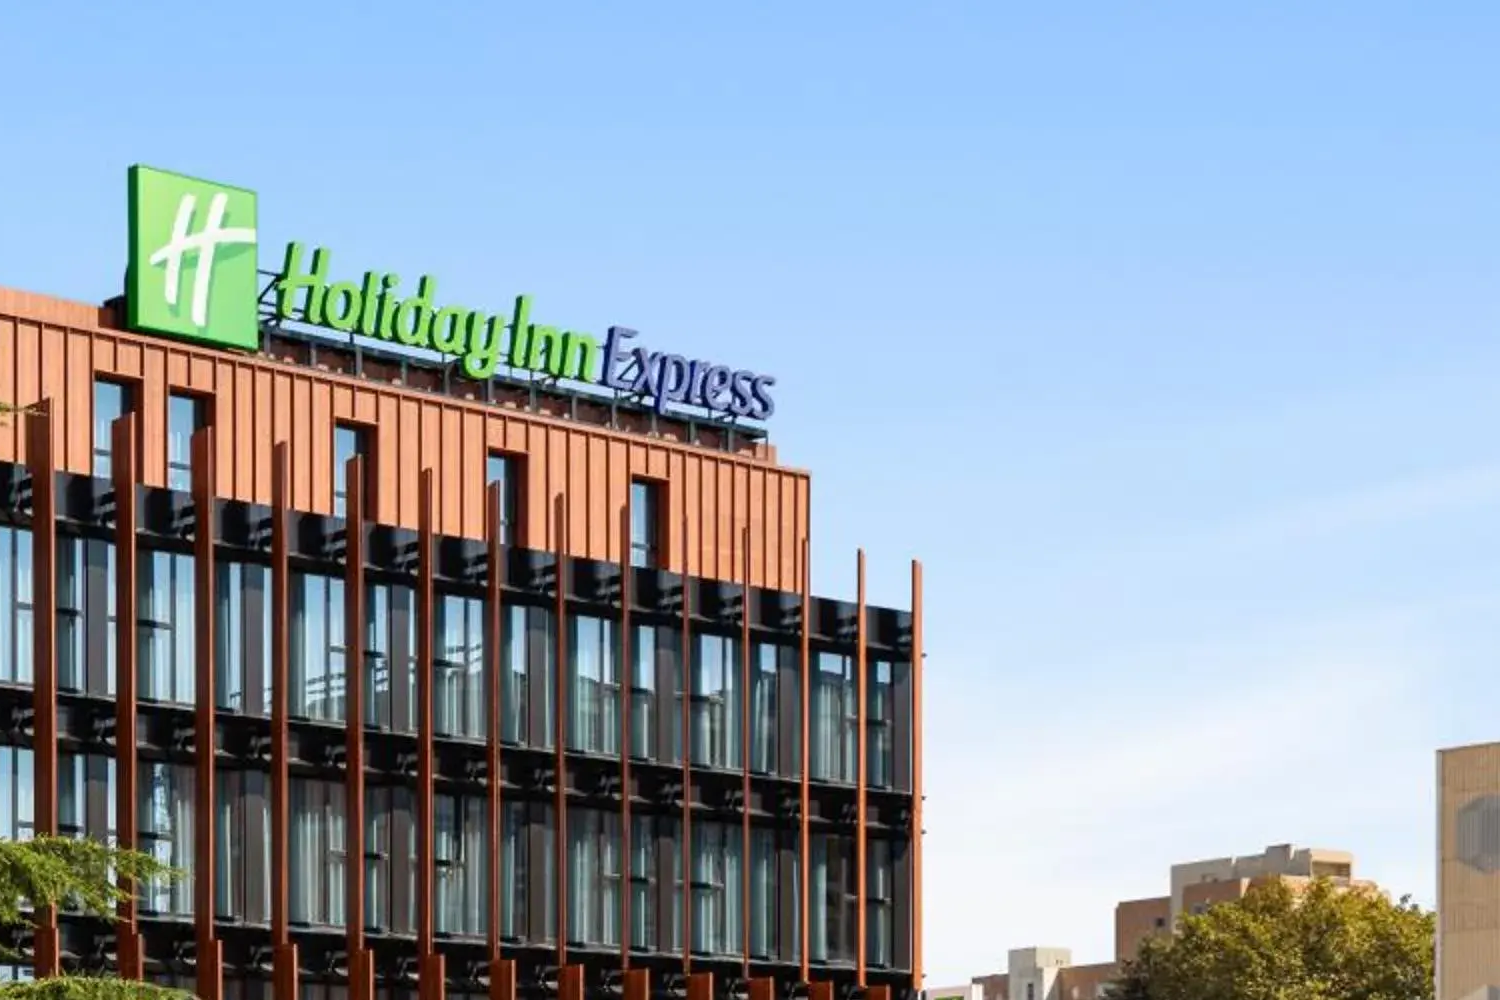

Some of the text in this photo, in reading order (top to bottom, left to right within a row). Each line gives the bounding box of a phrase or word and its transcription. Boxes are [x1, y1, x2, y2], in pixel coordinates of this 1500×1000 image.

[275, 240, 776, 421] Holiday Inn Express
